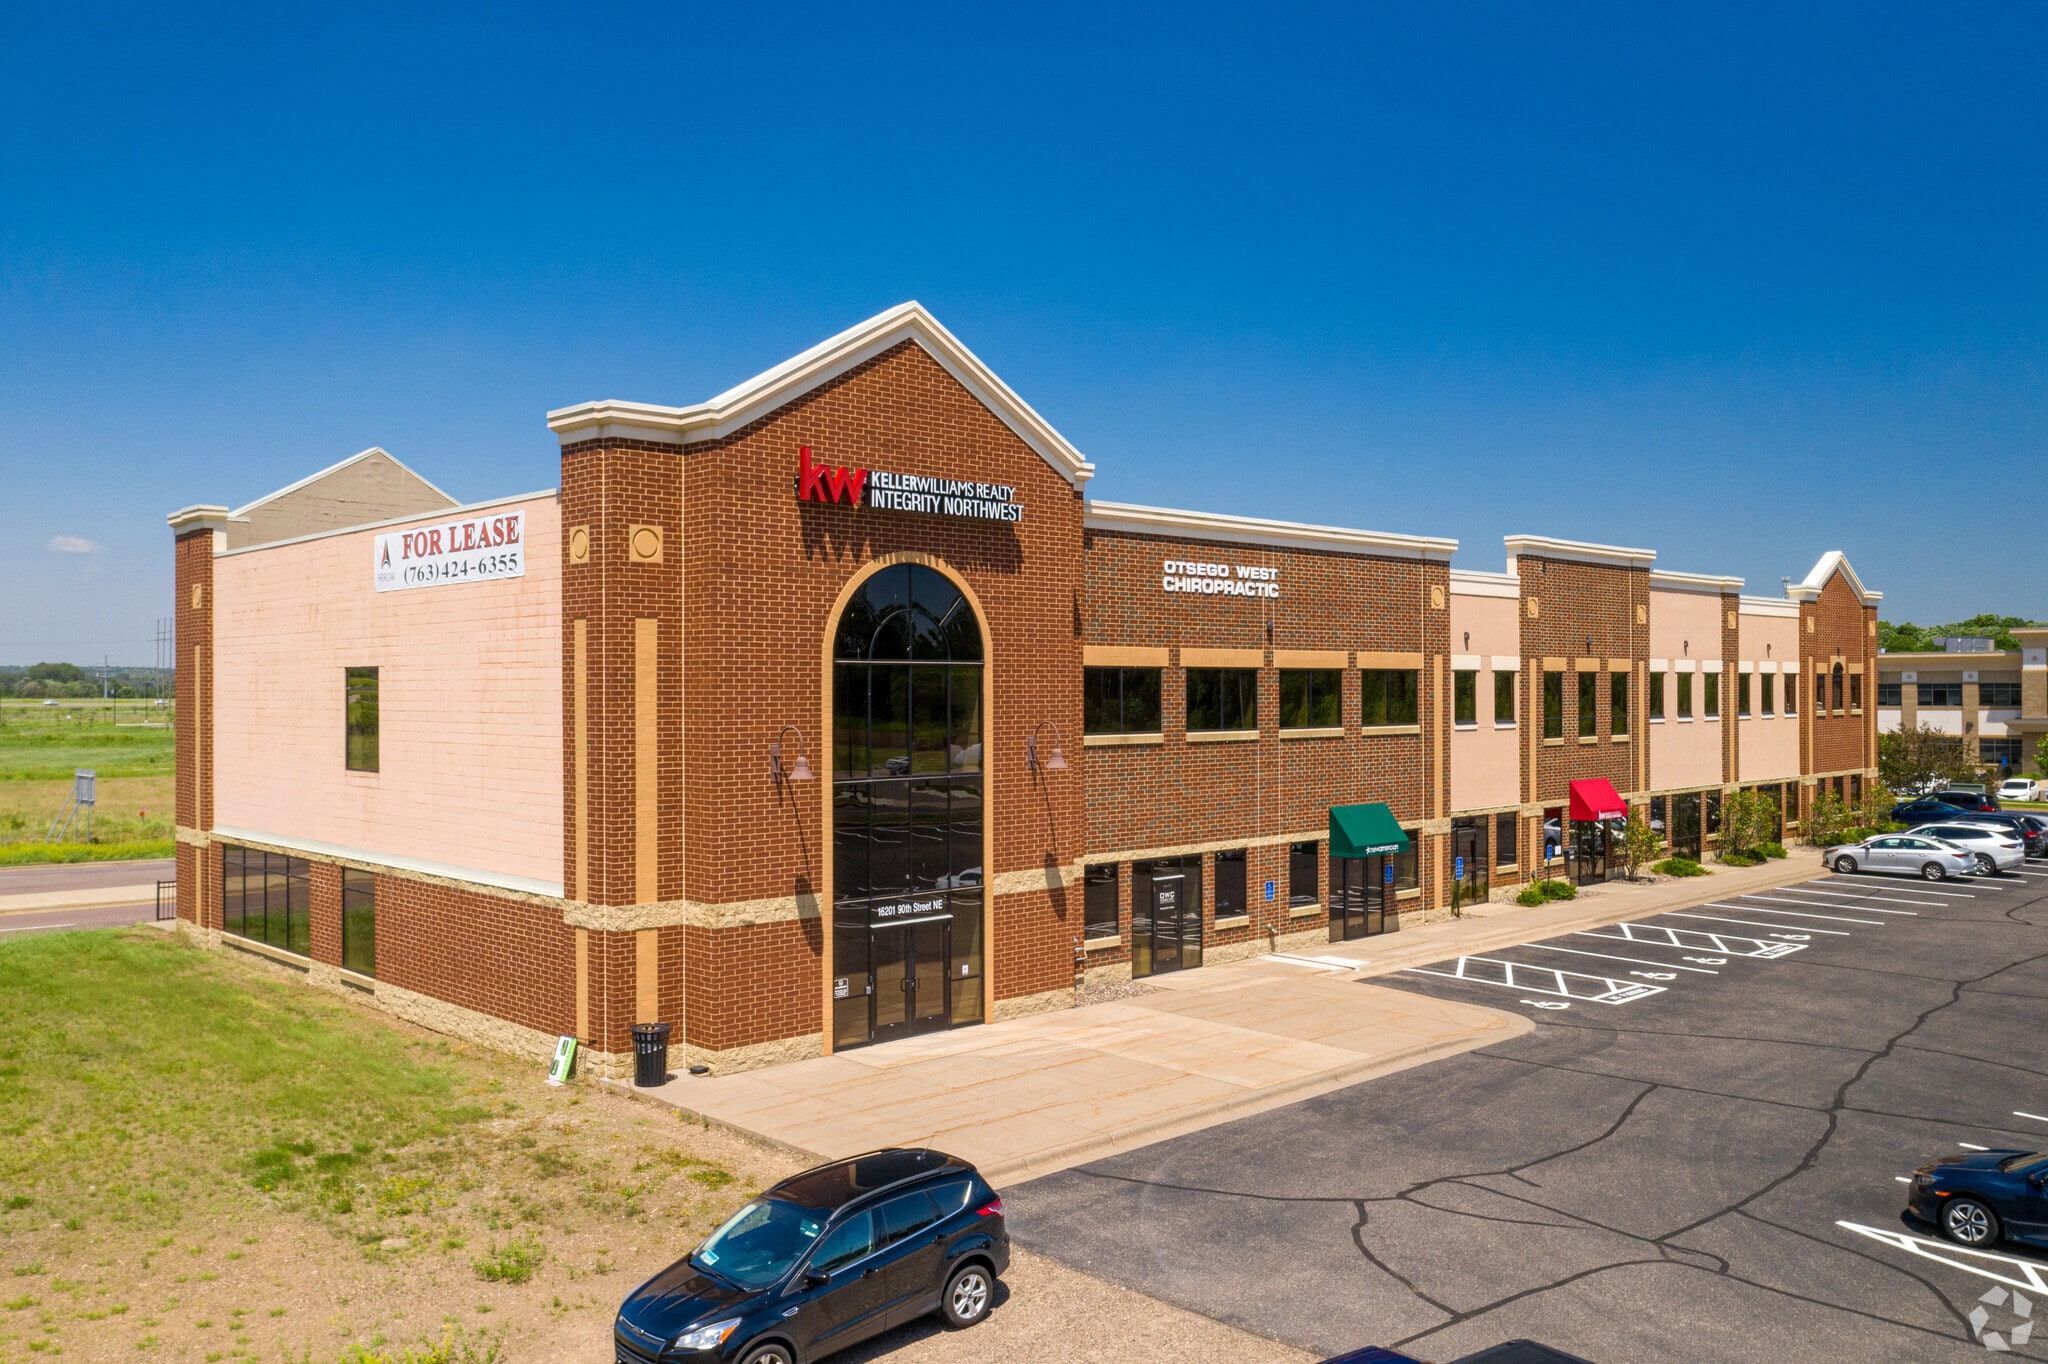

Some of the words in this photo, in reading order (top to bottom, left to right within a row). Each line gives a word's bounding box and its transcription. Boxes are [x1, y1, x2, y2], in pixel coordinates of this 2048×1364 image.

[799, 446, 868, 506] kw
[976, 483, 1016, 502] REALTY
[871, 488, 941, 514] INTEGRITY
[944, 496, 1025, 522] NORTHWEST
[402, 529, 442, 559] FOR
[449, 516, 519, 552] LEASE
[1164, 560, 1230, 578] OTSEGO
[1236, 565, 1278, 580] WEST
[1163, 577, 1280, 598] CHIROPRACTIC
[878, 905, 896, 917] 16201
[897, 903, 912, 914] 90th
[913, 901, 932, 912] Street
[932, 899, 943, 910] NE
